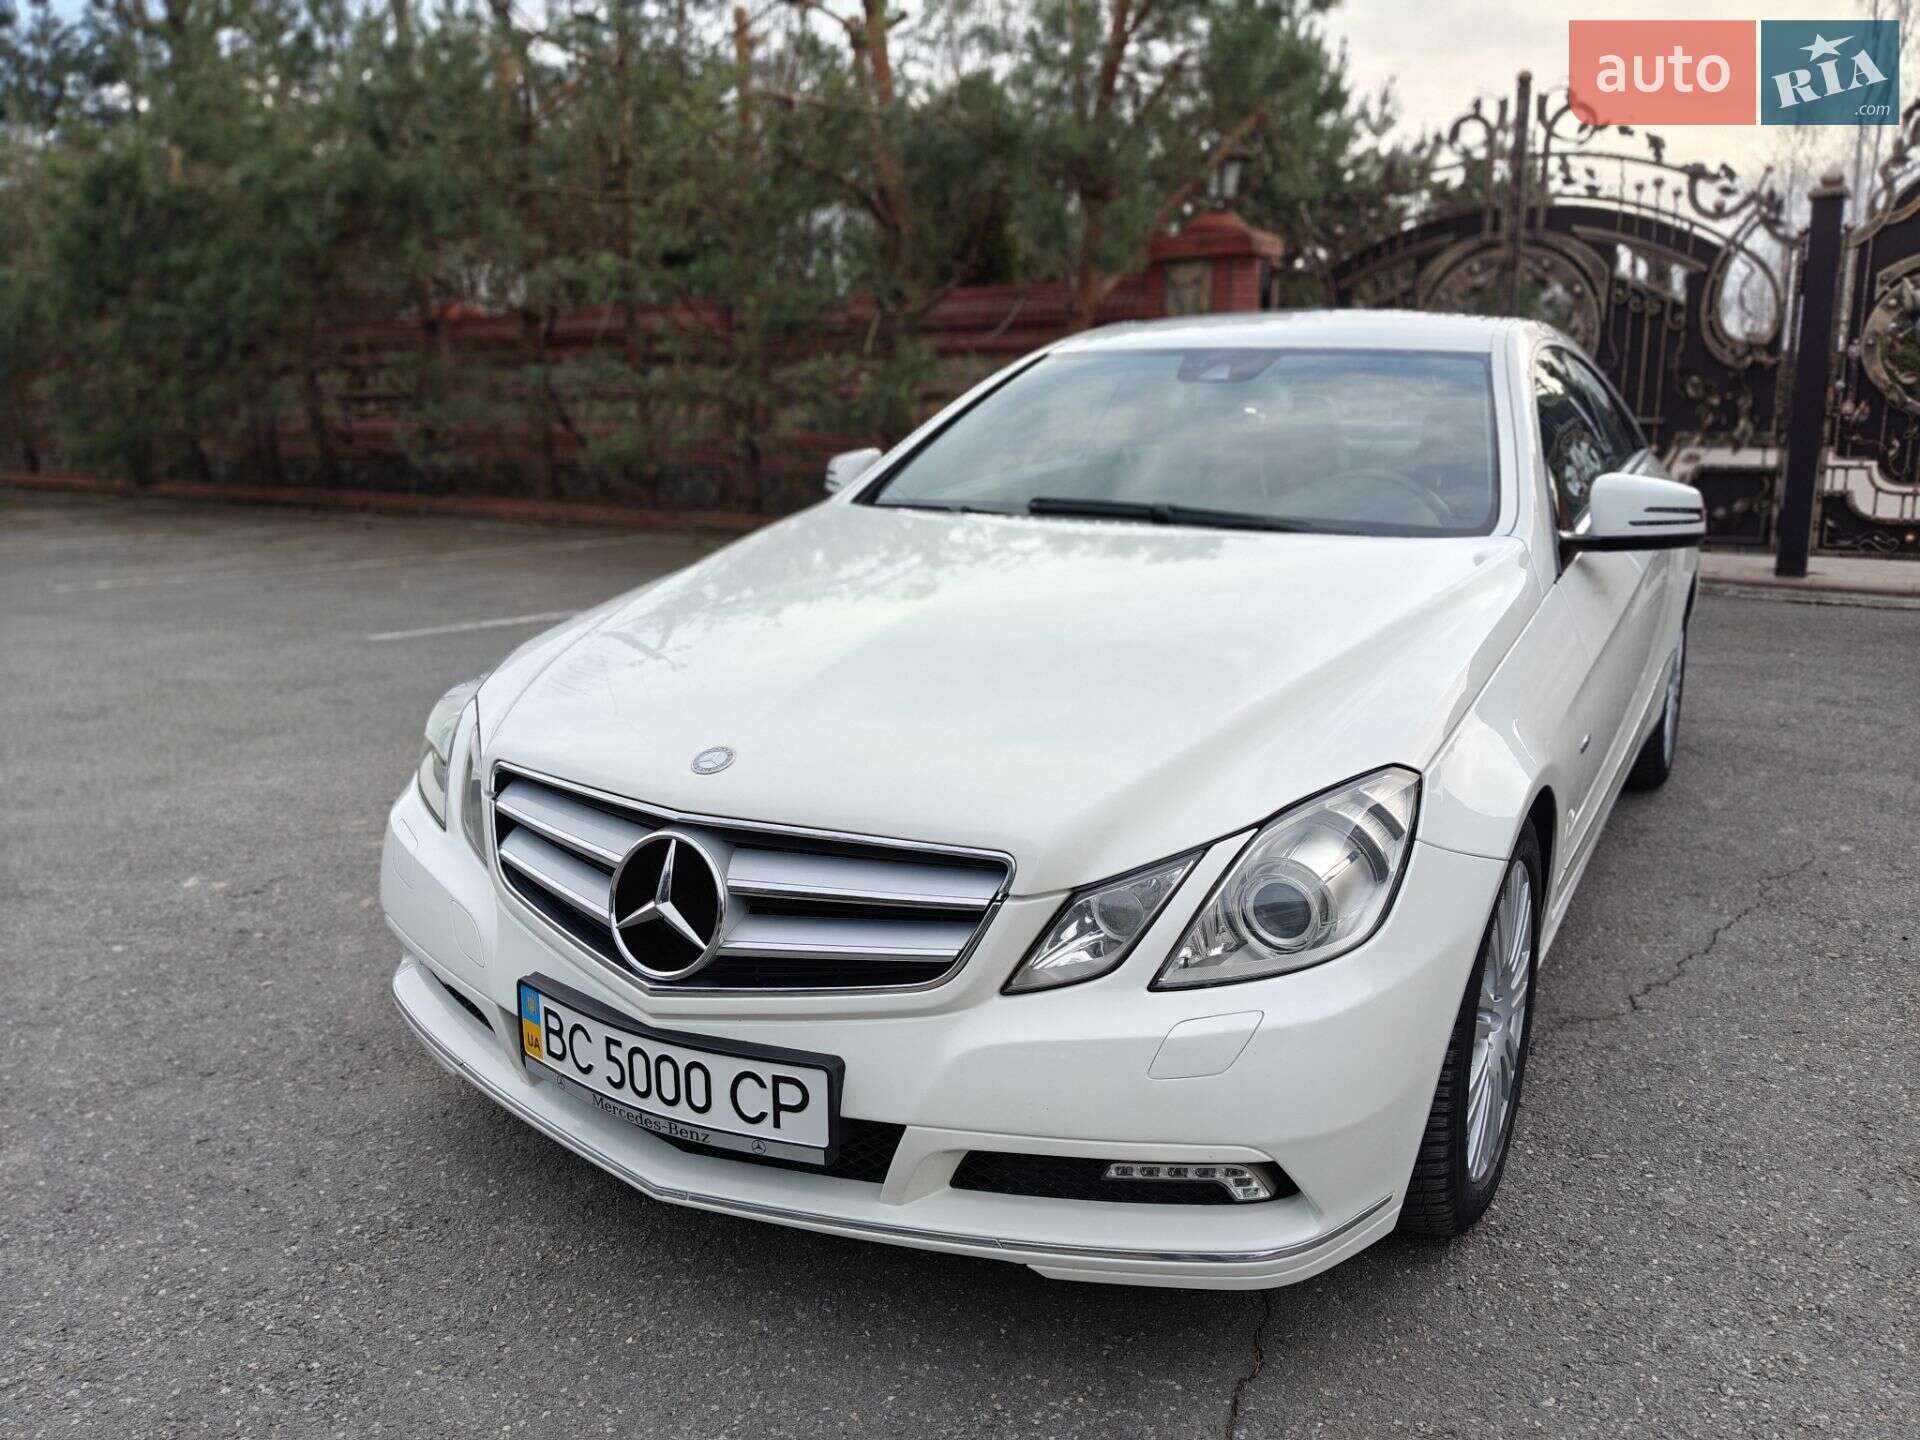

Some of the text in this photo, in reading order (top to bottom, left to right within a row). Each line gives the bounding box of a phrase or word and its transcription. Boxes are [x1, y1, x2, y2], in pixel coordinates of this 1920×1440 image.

[527, 1032, 541, 1051] UA
[543, 1005, 810, 1129] BC 5000 CP
[592, 1093, 712, 1144] Mercedes-Benz
